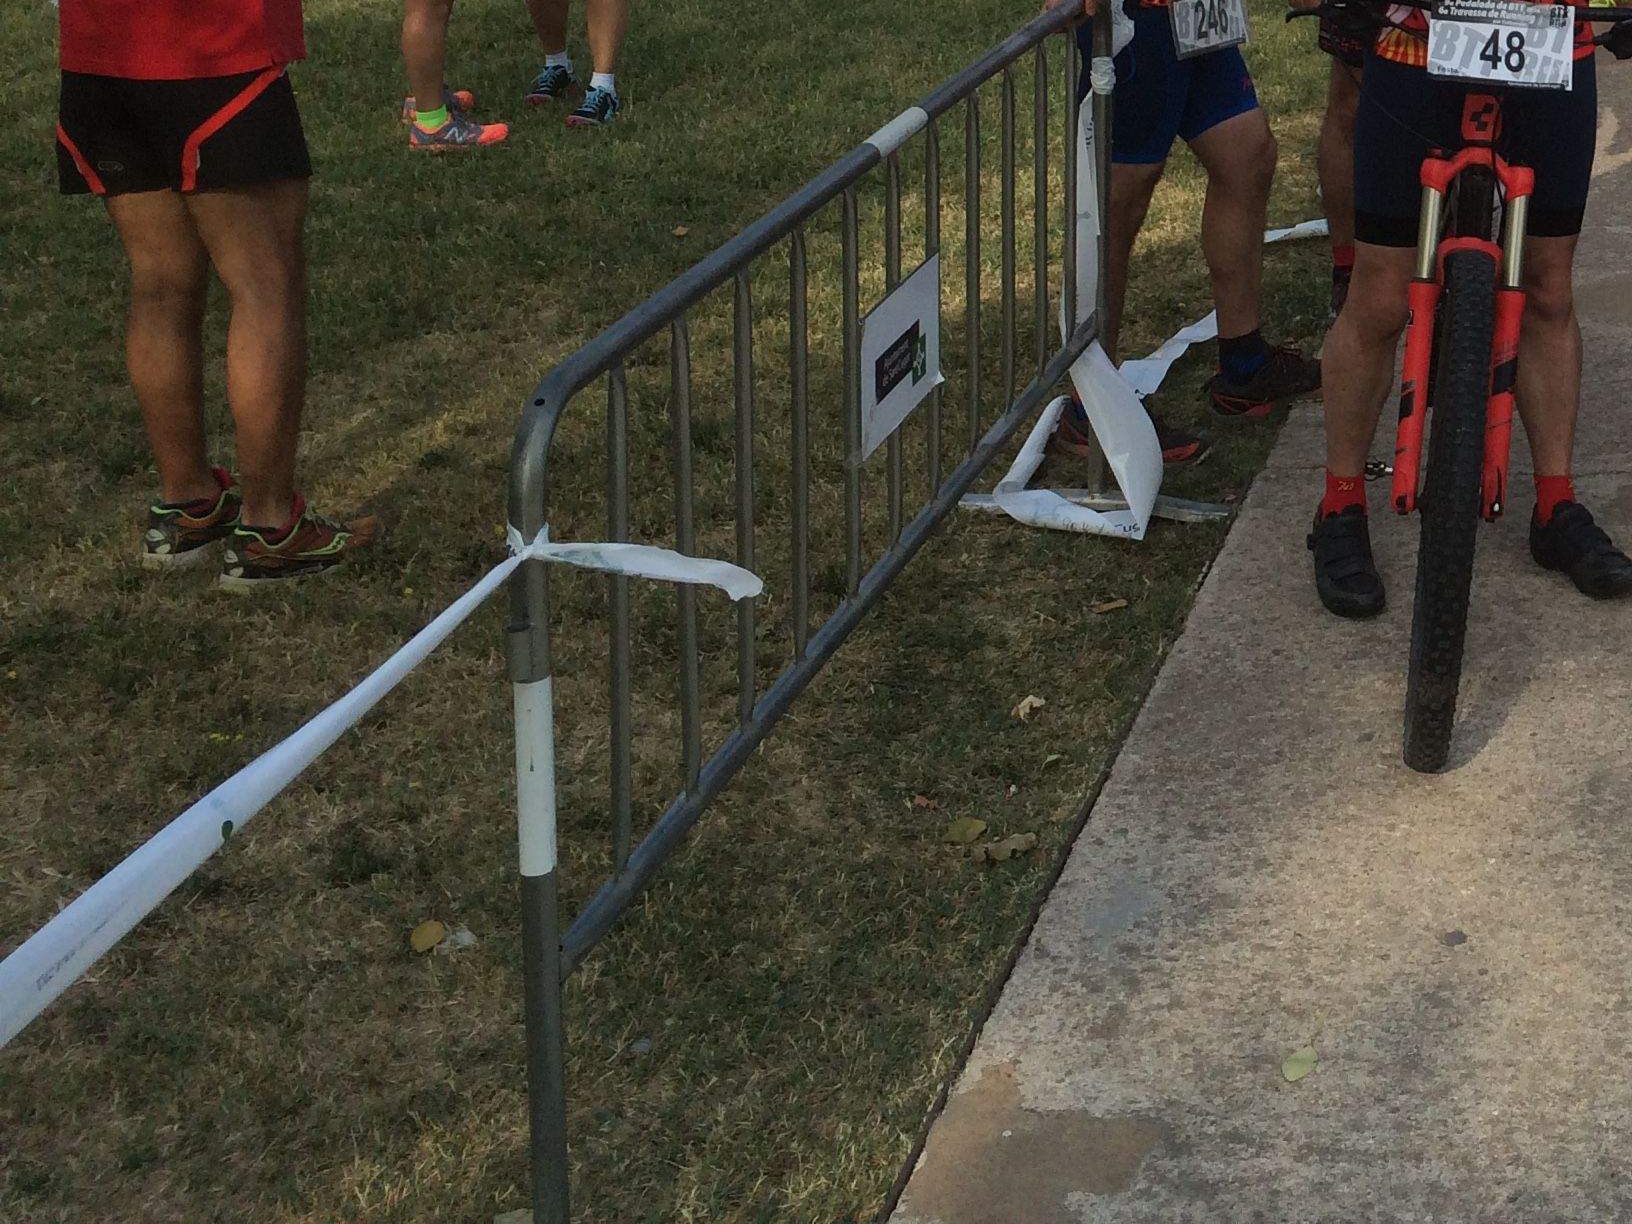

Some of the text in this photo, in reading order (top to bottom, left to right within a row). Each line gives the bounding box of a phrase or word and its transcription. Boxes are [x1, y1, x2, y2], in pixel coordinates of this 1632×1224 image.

[1450, 6, 1487, 17] Travessa
[1489, 9, 1499, 18] de
[1479, 28, 1526, 73] 48
